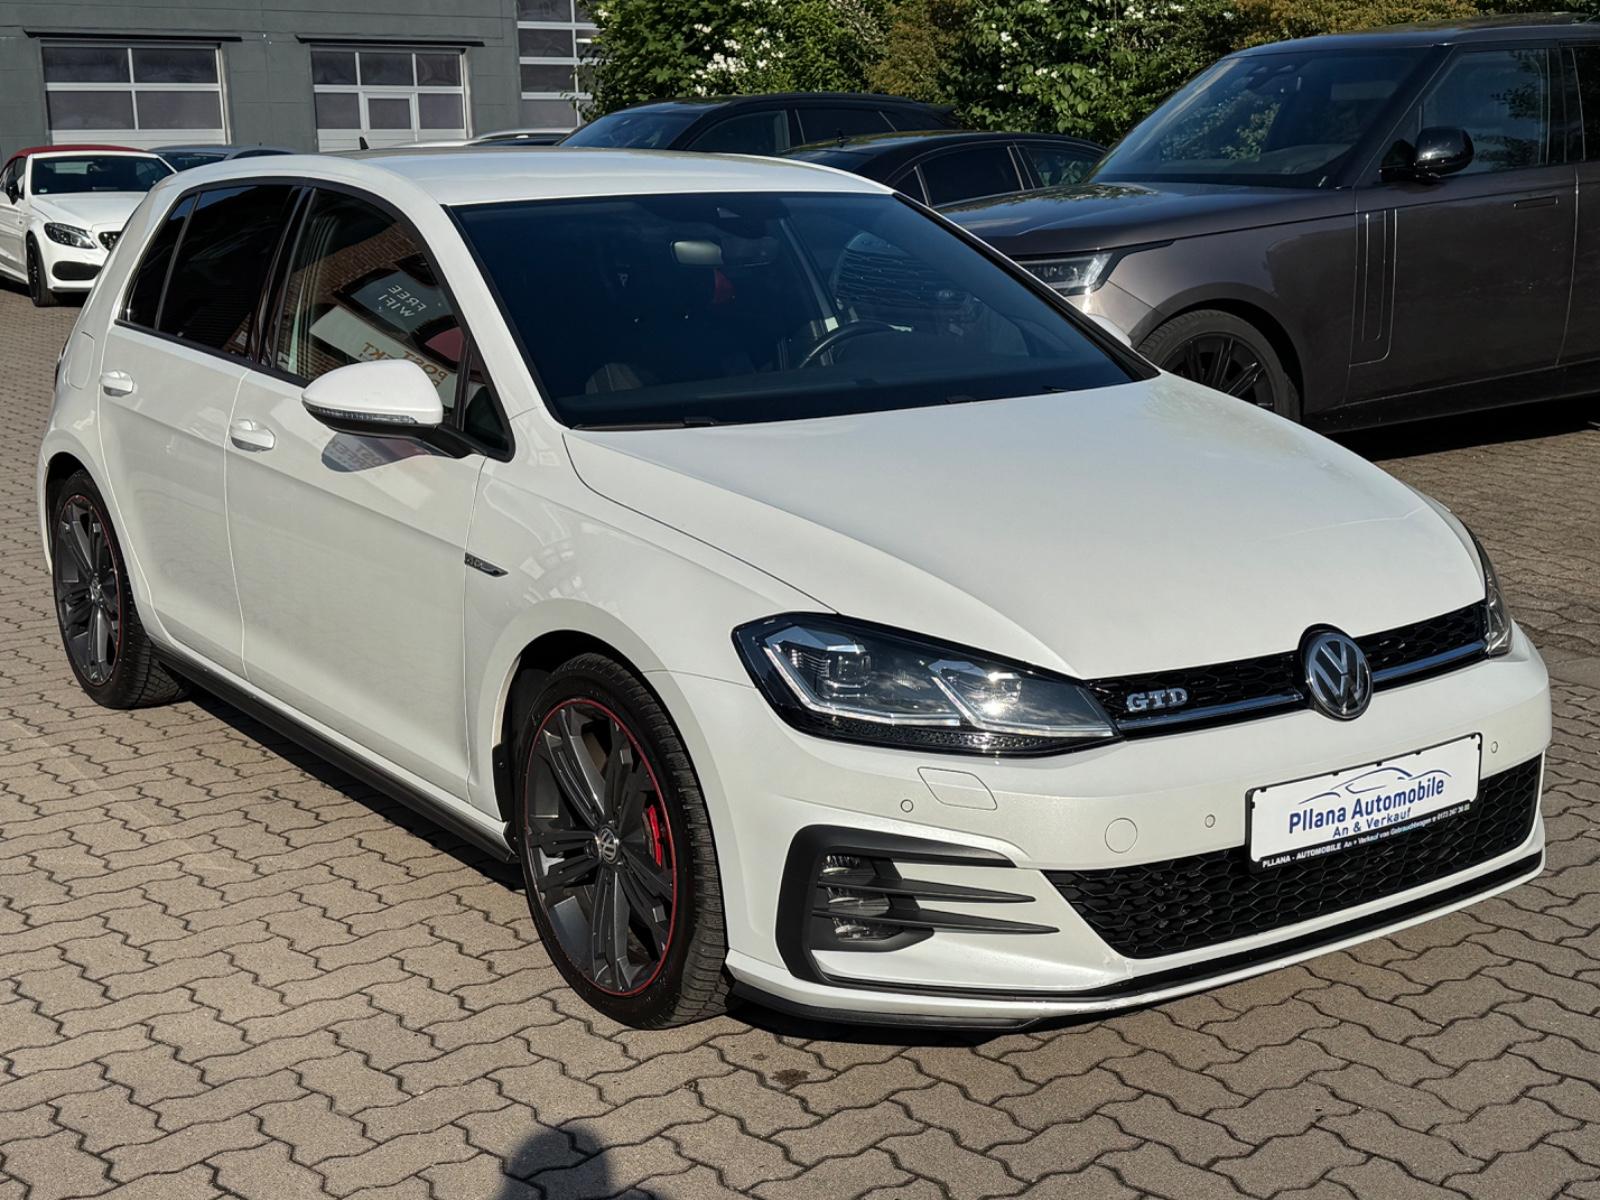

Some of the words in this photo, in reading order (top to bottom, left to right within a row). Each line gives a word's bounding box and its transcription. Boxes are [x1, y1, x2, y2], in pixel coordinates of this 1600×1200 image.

[1126, 688, 1188, 713] GTD
[1289, 807, 1347, 834] Pllana
[1351, 776, 1444, 820] Automobile
[1332, 826, 1349, 839] An
[1353, 821, 1362, 833] &
[1366, 807, 1411, 830] Verkauf
[1262, 855, 1291, 868] PLLANA
[1296, 842, 1342, 860] AUTOMOBILE
